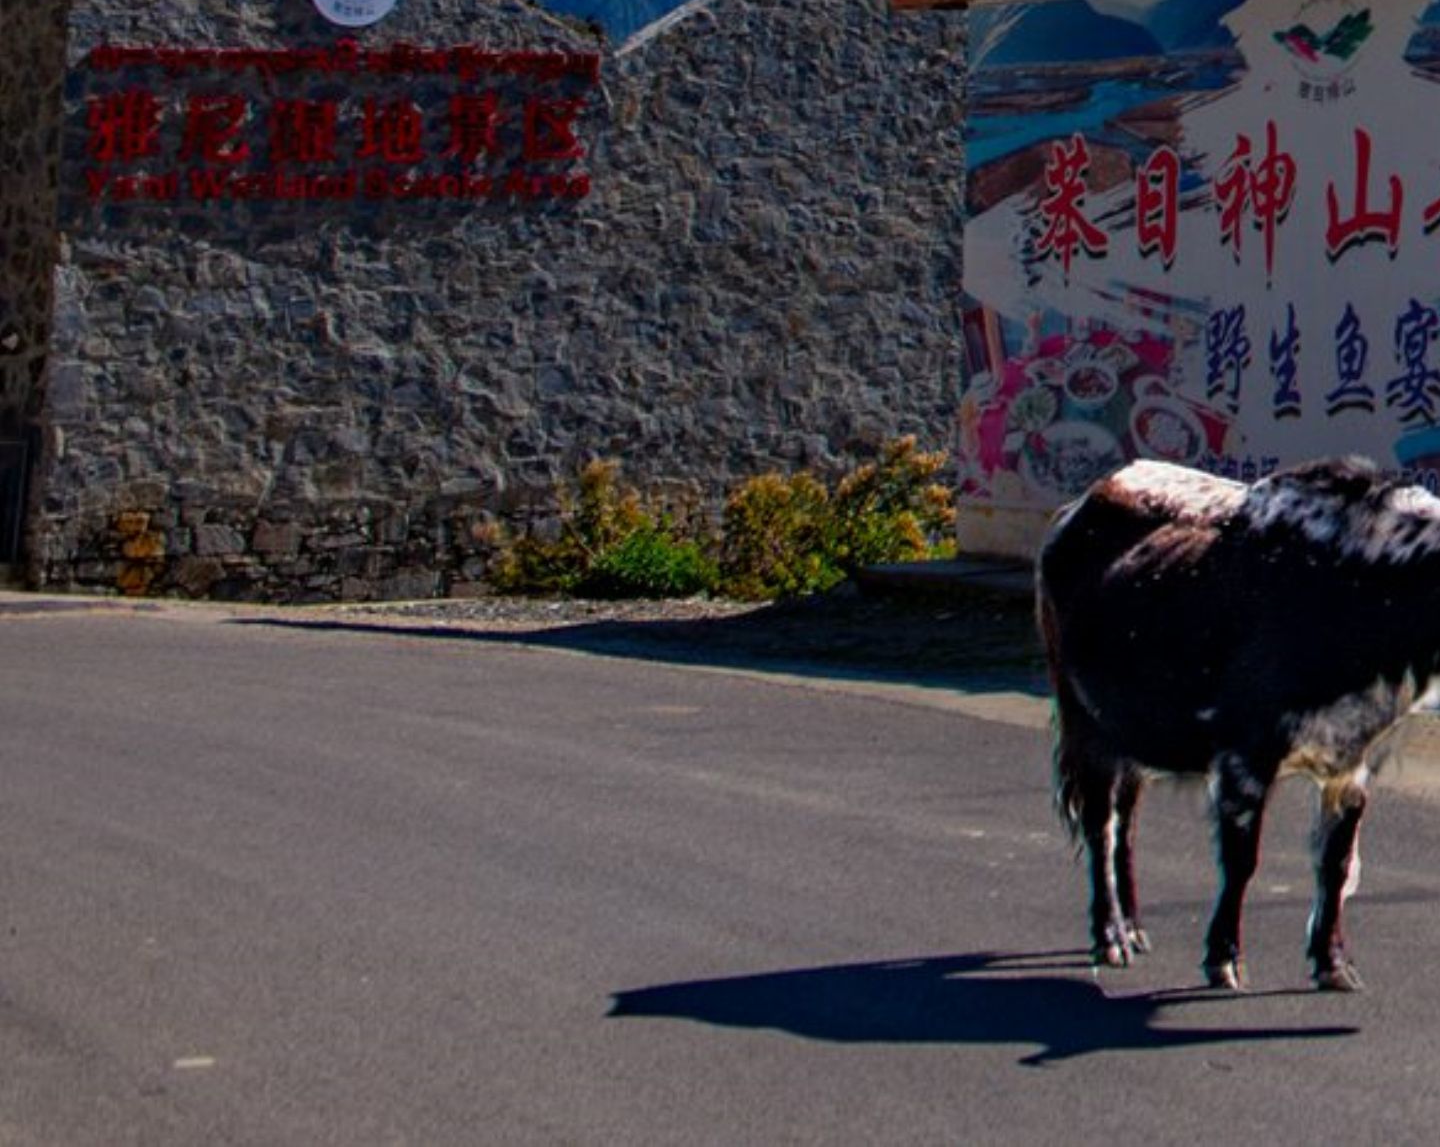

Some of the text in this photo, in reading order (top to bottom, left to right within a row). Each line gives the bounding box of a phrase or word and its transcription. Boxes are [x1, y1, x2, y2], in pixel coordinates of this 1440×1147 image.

[86, 87, 588, 163] 雅尼湿地景区
[505, 169, 591, 197] Area
